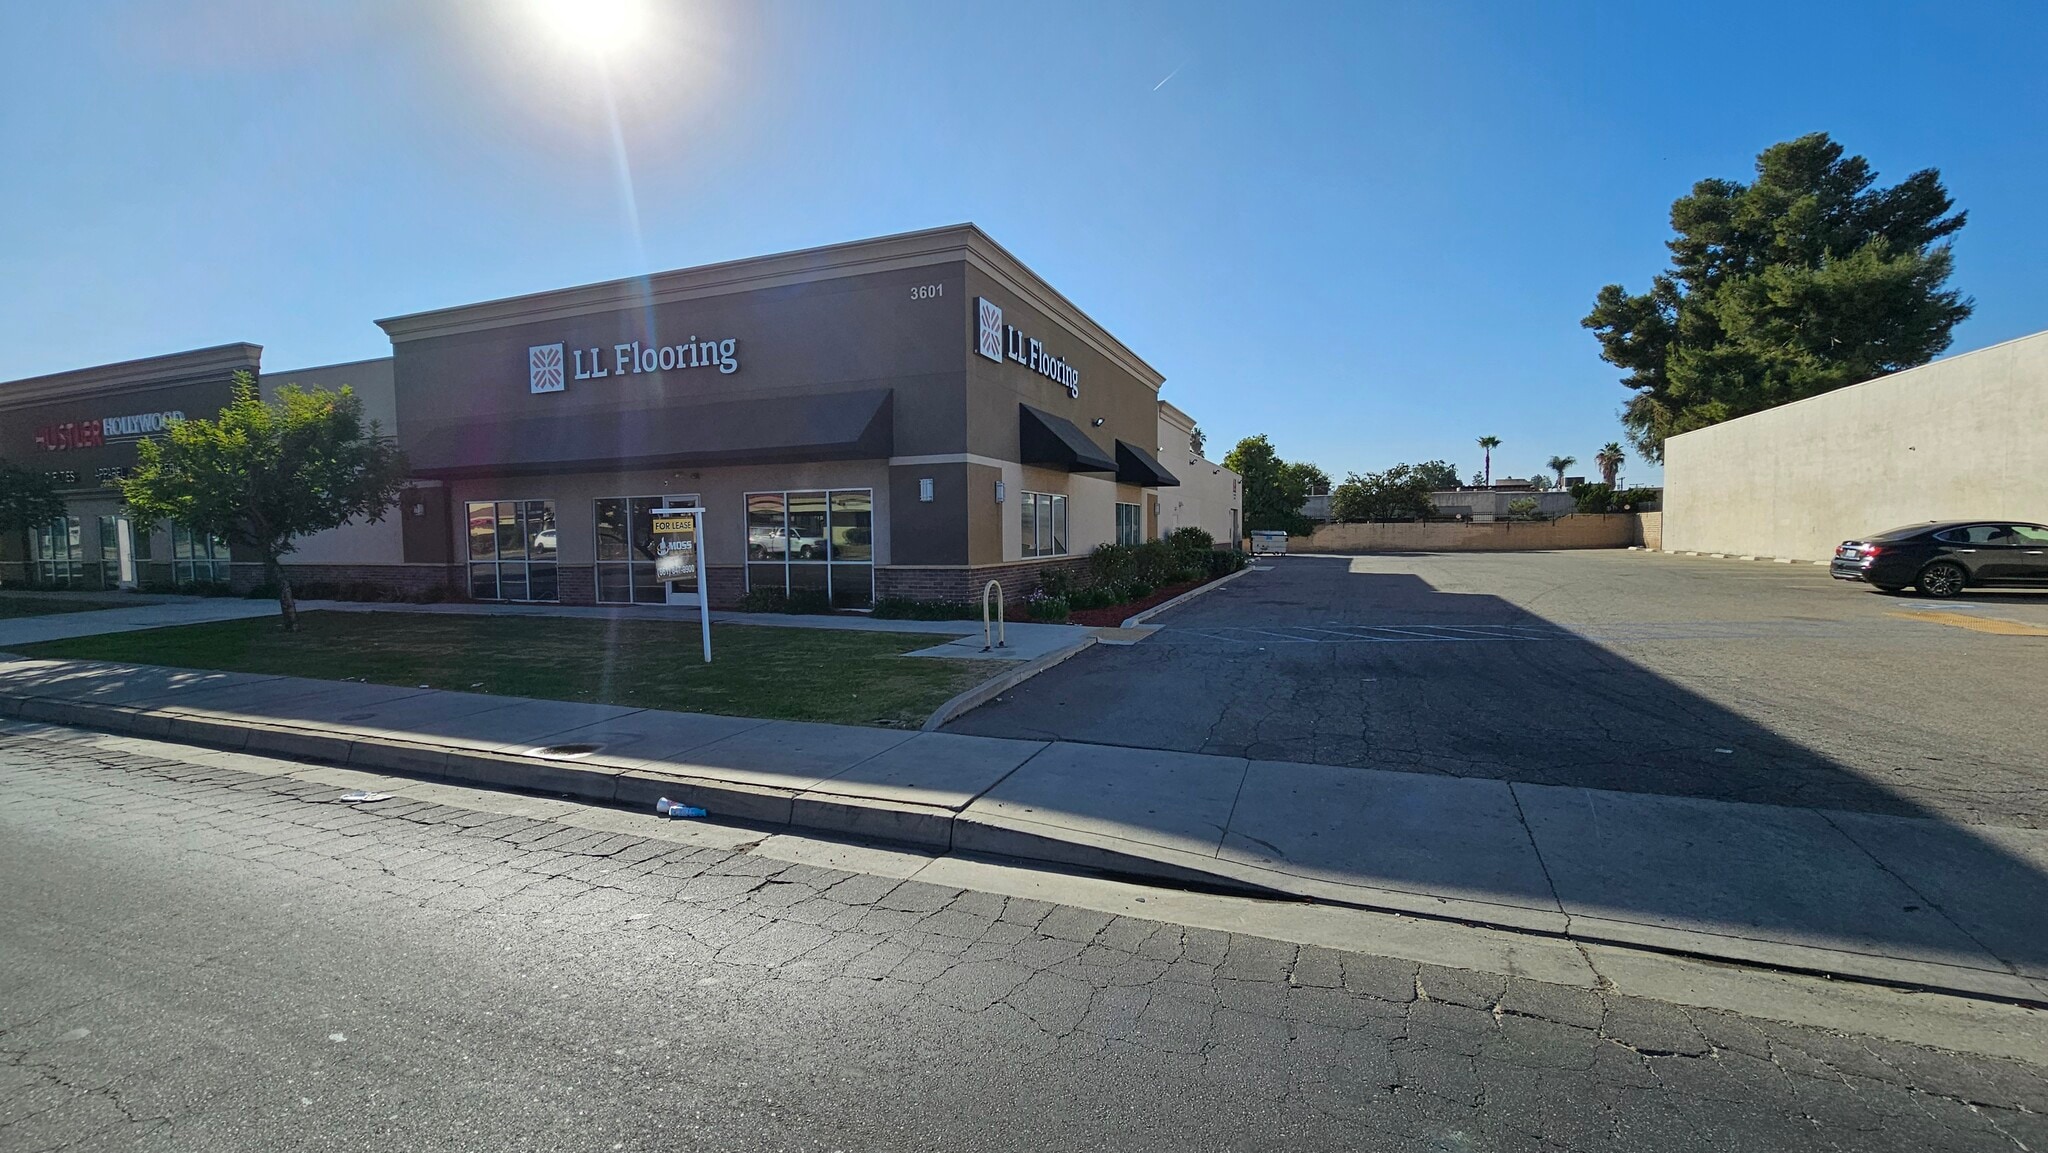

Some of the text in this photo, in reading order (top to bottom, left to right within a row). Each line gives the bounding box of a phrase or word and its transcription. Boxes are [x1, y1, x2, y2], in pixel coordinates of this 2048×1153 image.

[910, 283, 943, 300] 3601
[573, 335, 738, 380] LL Flooring
[1006, 324, 1079, 399] LL Flooring
[33, 410, 185, 450] HUSTLER HOLLYWOOD
[655, 521, 691, 530] FOR LEASE
[669, 541, 692, 550] MOSS
